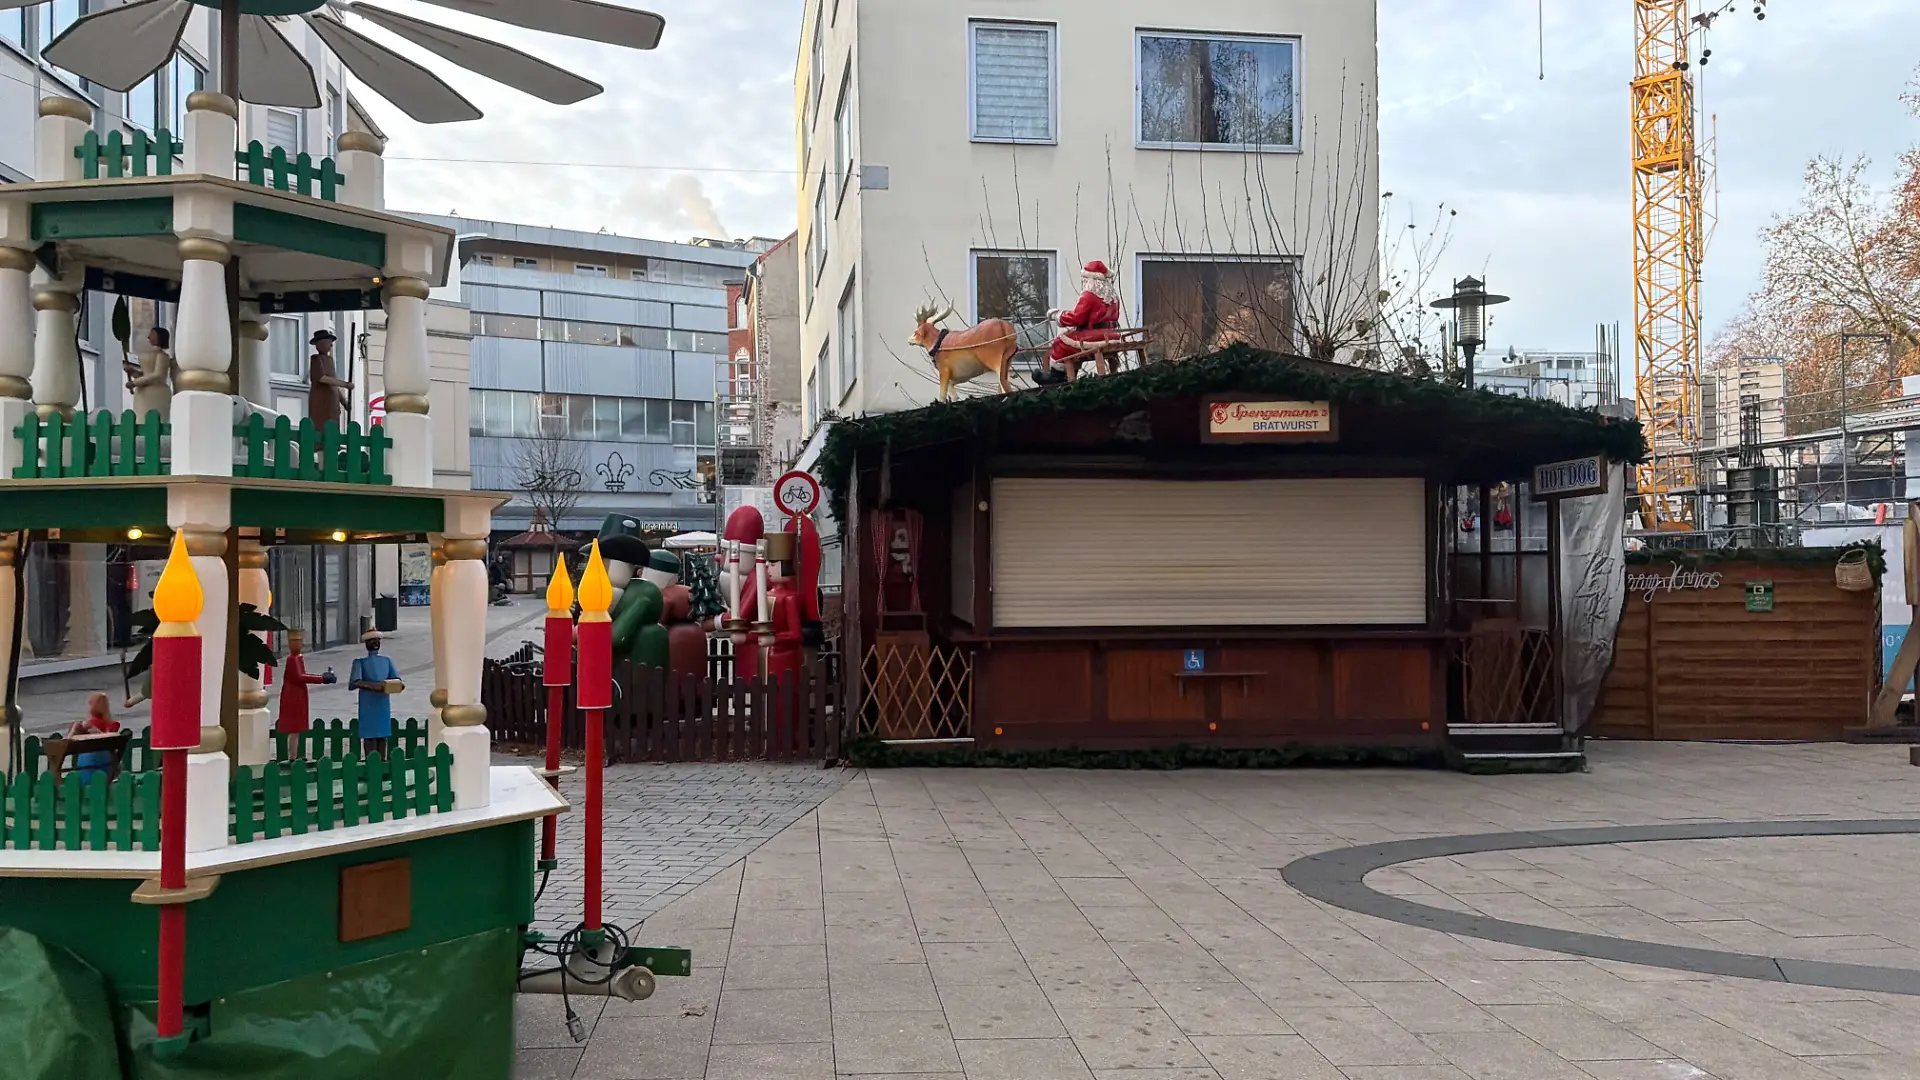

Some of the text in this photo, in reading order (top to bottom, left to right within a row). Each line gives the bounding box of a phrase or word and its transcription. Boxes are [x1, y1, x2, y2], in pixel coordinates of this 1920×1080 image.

[1252, 420, 1319, 431] BRATWURST
[1540, 459, 1597, 490] HOT DOG
